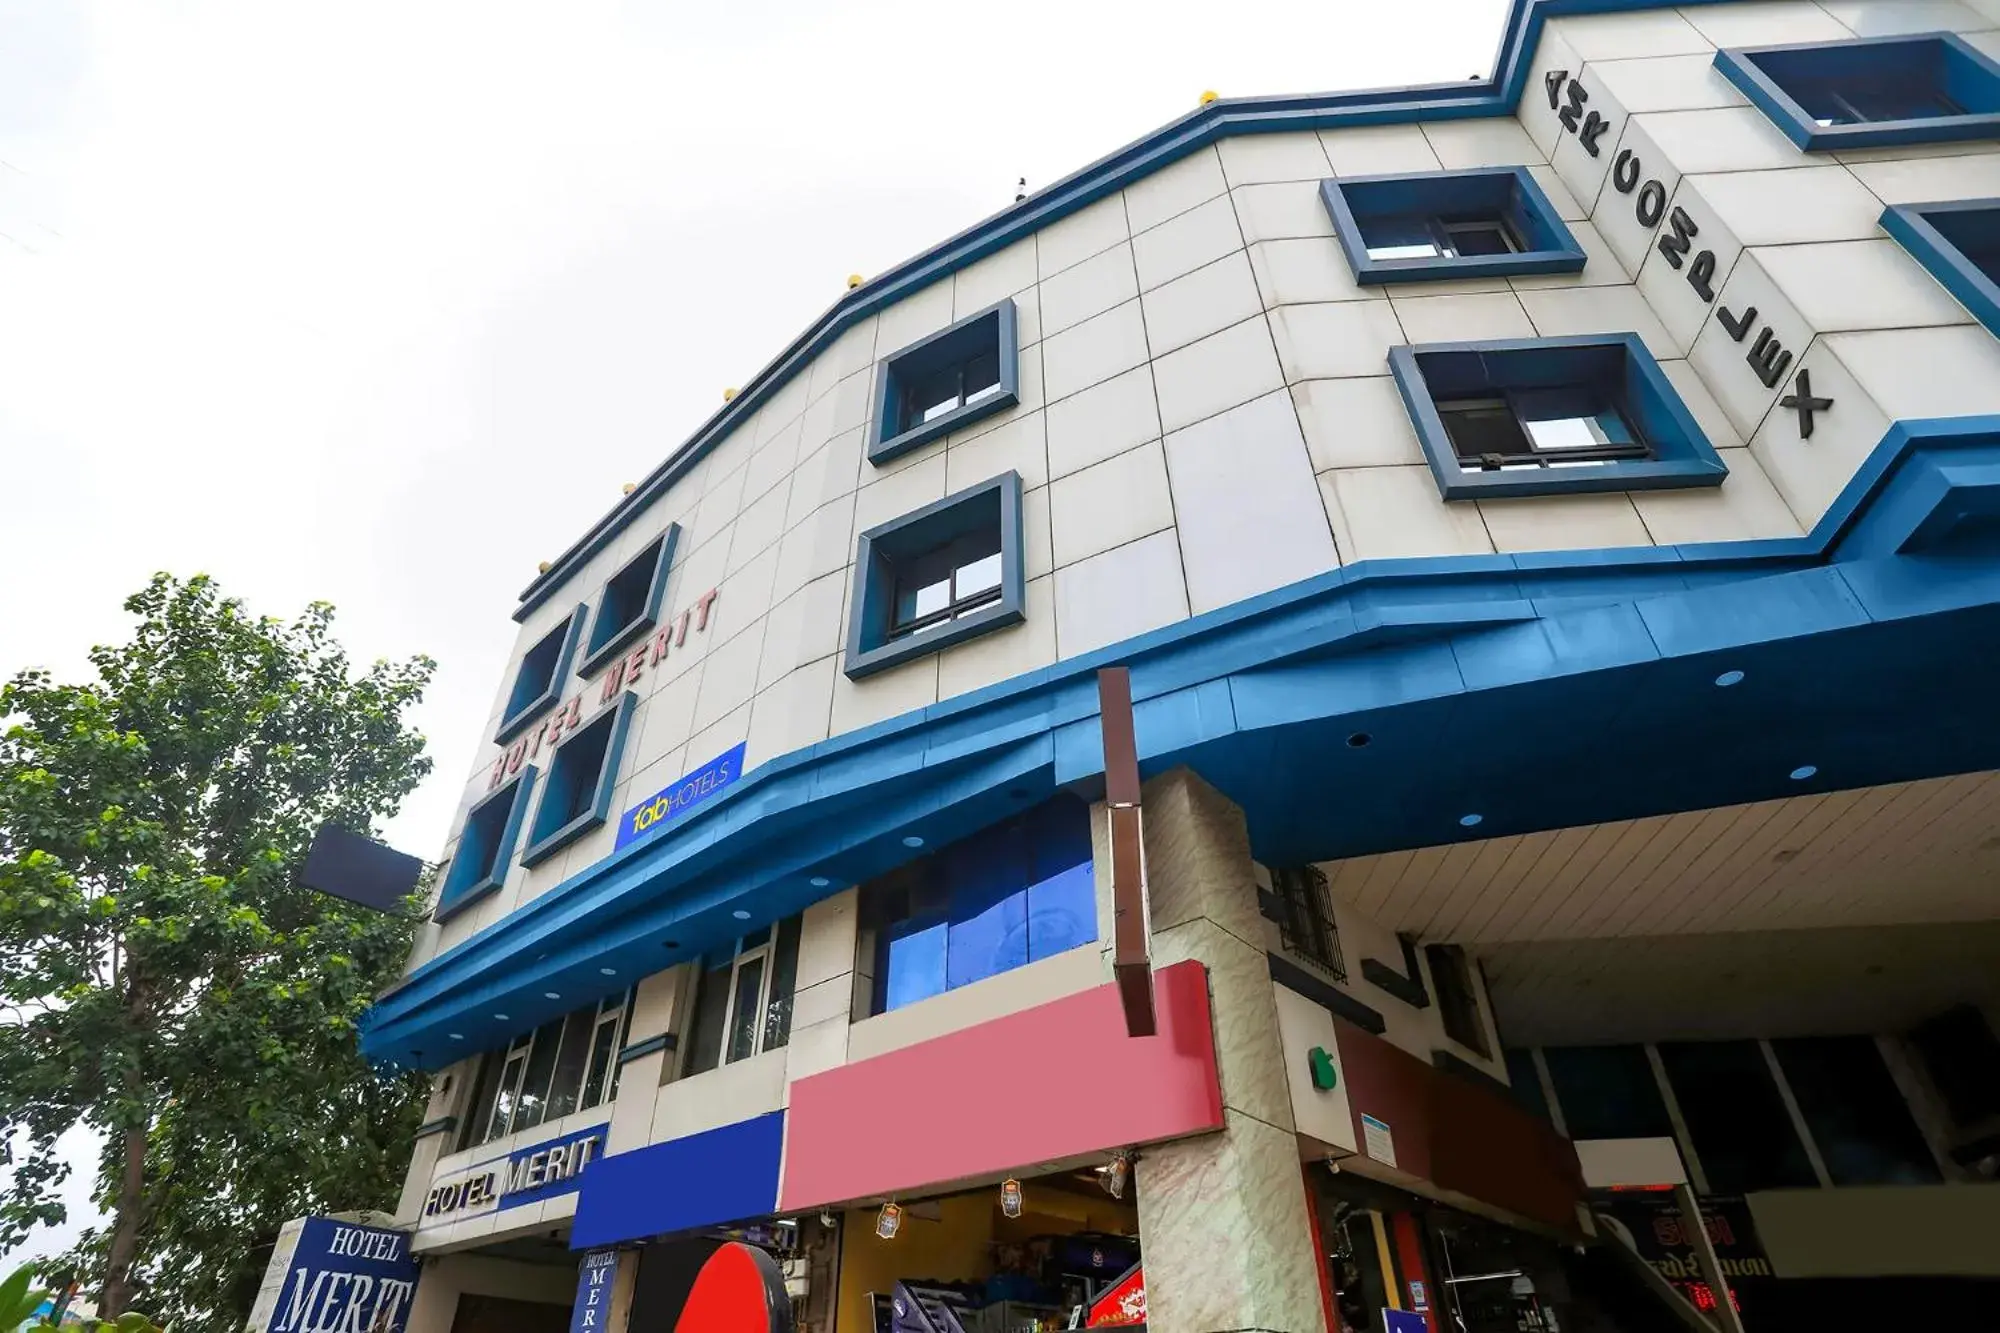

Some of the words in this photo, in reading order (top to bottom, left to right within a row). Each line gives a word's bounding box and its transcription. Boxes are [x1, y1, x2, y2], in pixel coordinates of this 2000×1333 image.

[1612, 148, 1835, 440] COMPLEX
[488, 693, 583, 791] HOTEL
[598, 586, 718, 705] MERIT
[426, 1172, 496, 1216] HOTEL
[501, 1135, 600, 1196] MERIT
[327, 1226, 401, 1262] HOTEL
[586, 1250, 615, 1269] HOTEL
[274, 1267, 414, 1333] MERIT
[582, 1267, 607, 1333] MER
